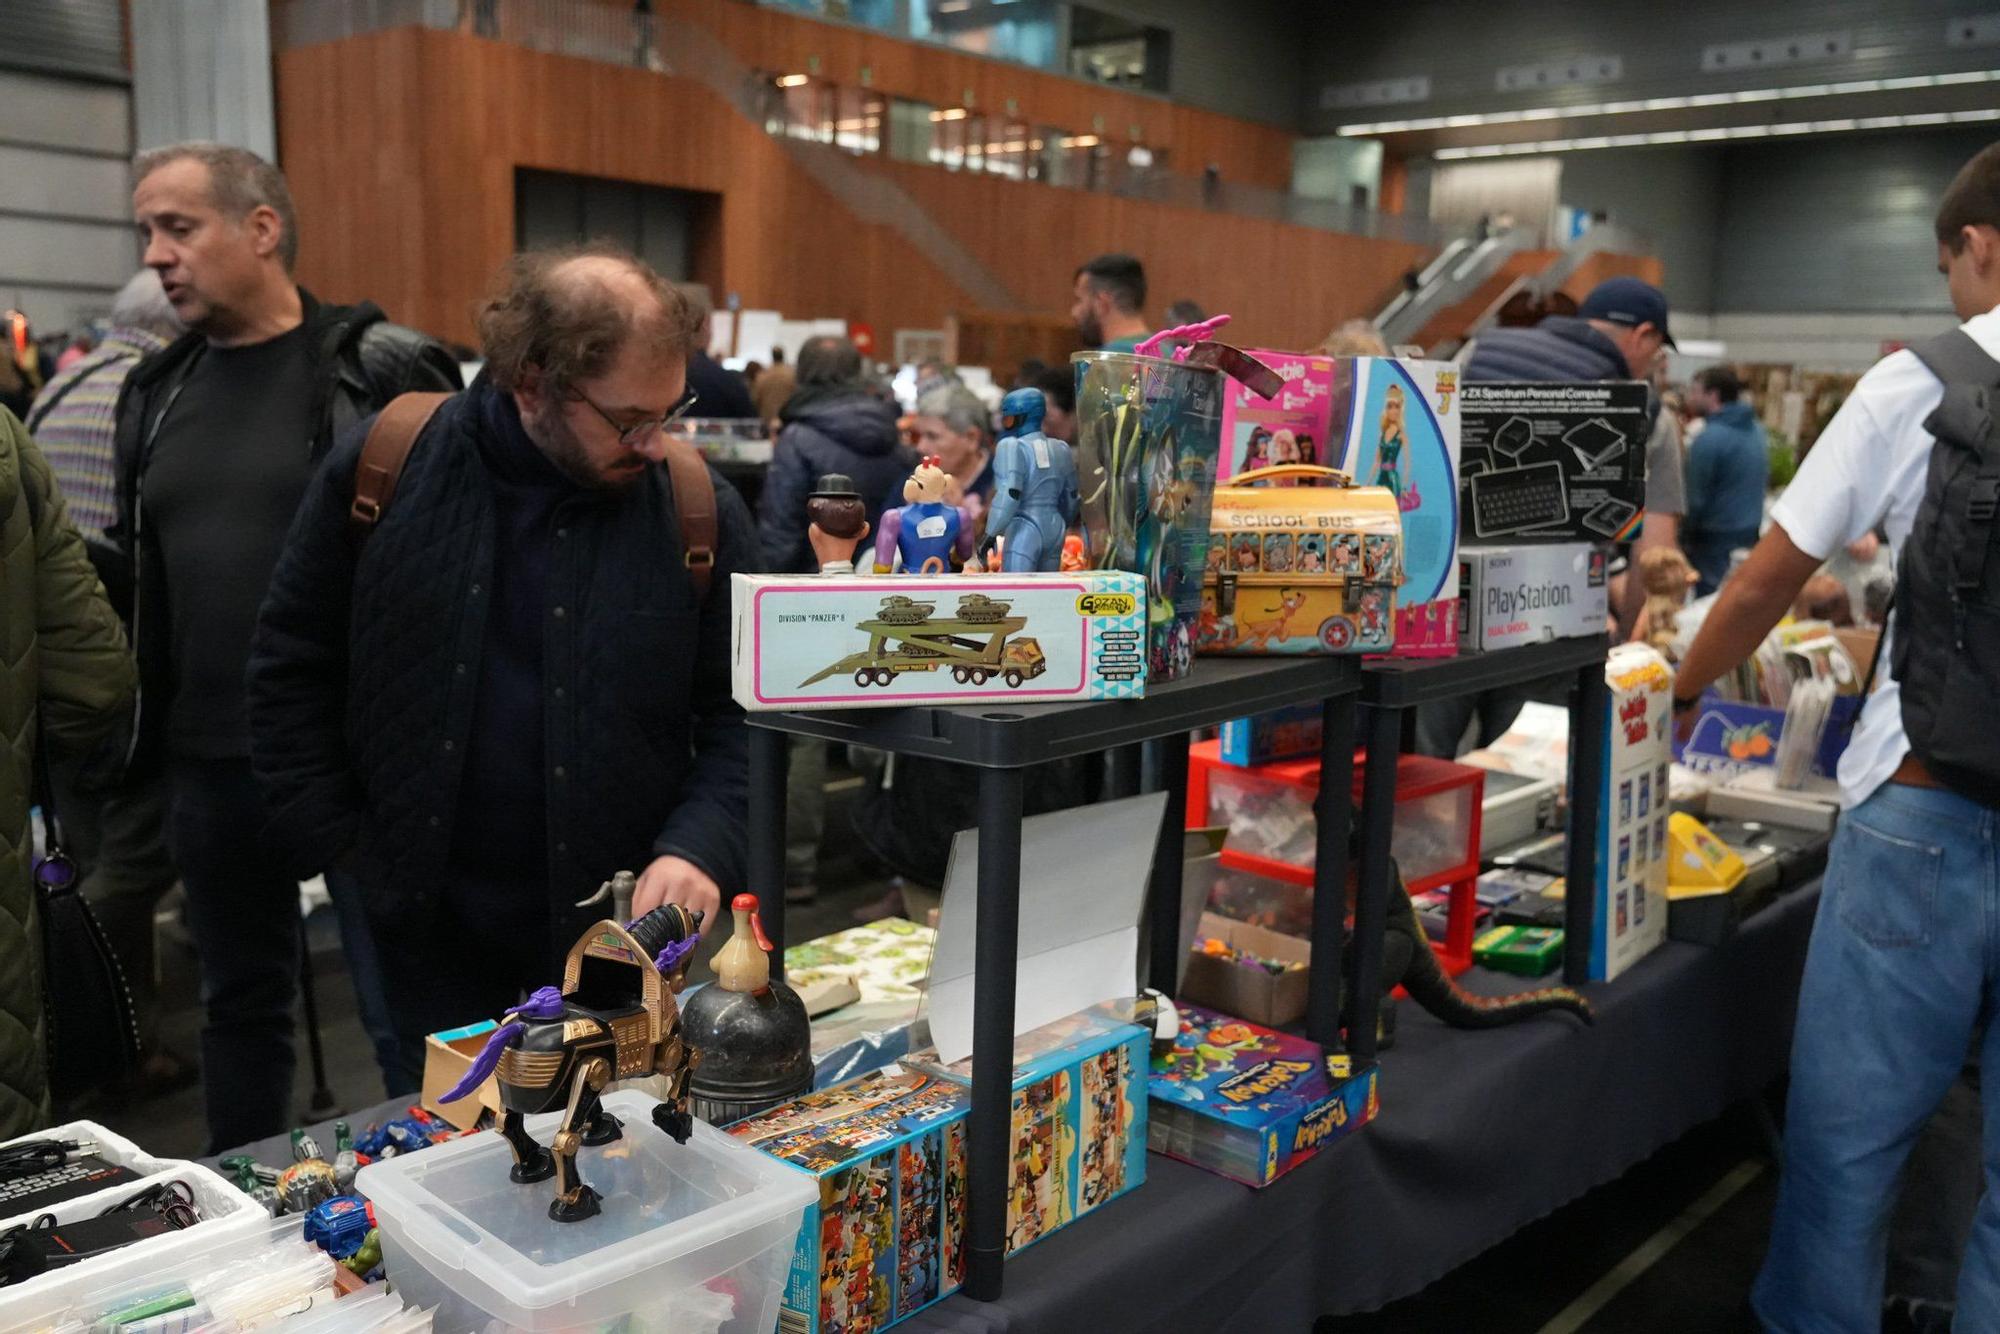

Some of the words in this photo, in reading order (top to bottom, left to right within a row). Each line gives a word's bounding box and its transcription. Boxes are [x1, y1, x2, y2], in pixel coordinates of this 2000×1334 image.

[1467, 387, 1480, 399] ZX
[1482, 387, 1526, 400] Spectrum
[1527, 387, 1565, 399] Personal
[1566, 387, 1611, 400] Computer
[1231, 514, 1304, 527] SCHOOL
[1317, 516, 1355, 528] BUS
[1489, 557, 1513, 569] SONY
[1488, 580, 1571, 622] PlayStation
[778, 614, 806, 623] DIVISION
